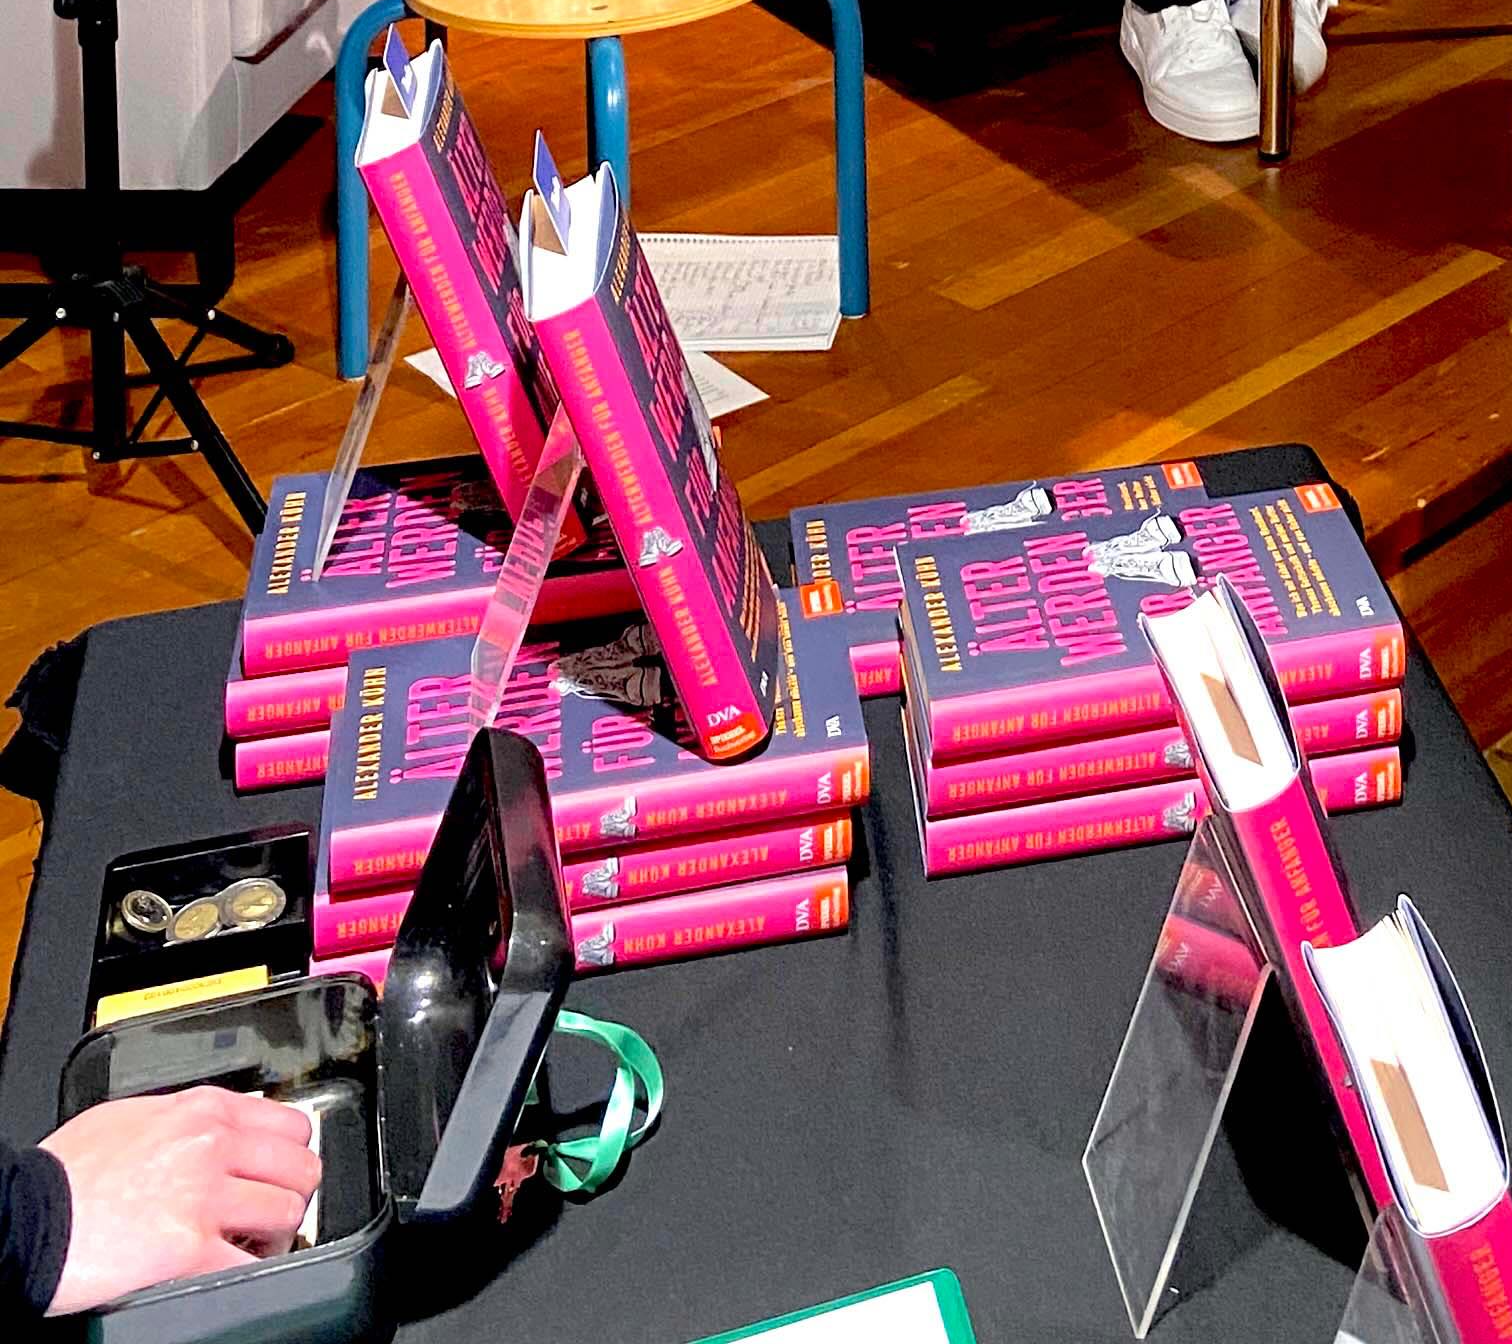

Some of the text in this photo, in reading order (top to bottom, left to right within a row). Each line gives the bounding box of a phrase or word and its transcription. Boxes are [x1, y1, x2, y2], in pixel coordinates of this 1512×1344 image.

[844, 522, 906, 614] ÄLTER
[914, 555, 941, 588] KÜHN
[960, 556, 1050, 657] ÄLTER
[1024, 531, 1128, 667] WERDEN
[923, 591, 963, 672] ALEXANDER
[1360, 648, 1371, 680] DVA
[390, 674, 490, 784] ÄLTER
[706, 704, 742, 727] DVA
[1356, 709, 1368, 739] DVA
[353, 667, 387, 800] ALEXANDER KÜHN
[582, 716, 656, 773] FÜR
[817, 772, 832, 804] DVA
[1355, 772, 1368, 804] DVA
[799, 827, 813, 862] DVA
[353, 850, 427, 875] NFÄNGER
[795, 899, 810, 931] DVA
